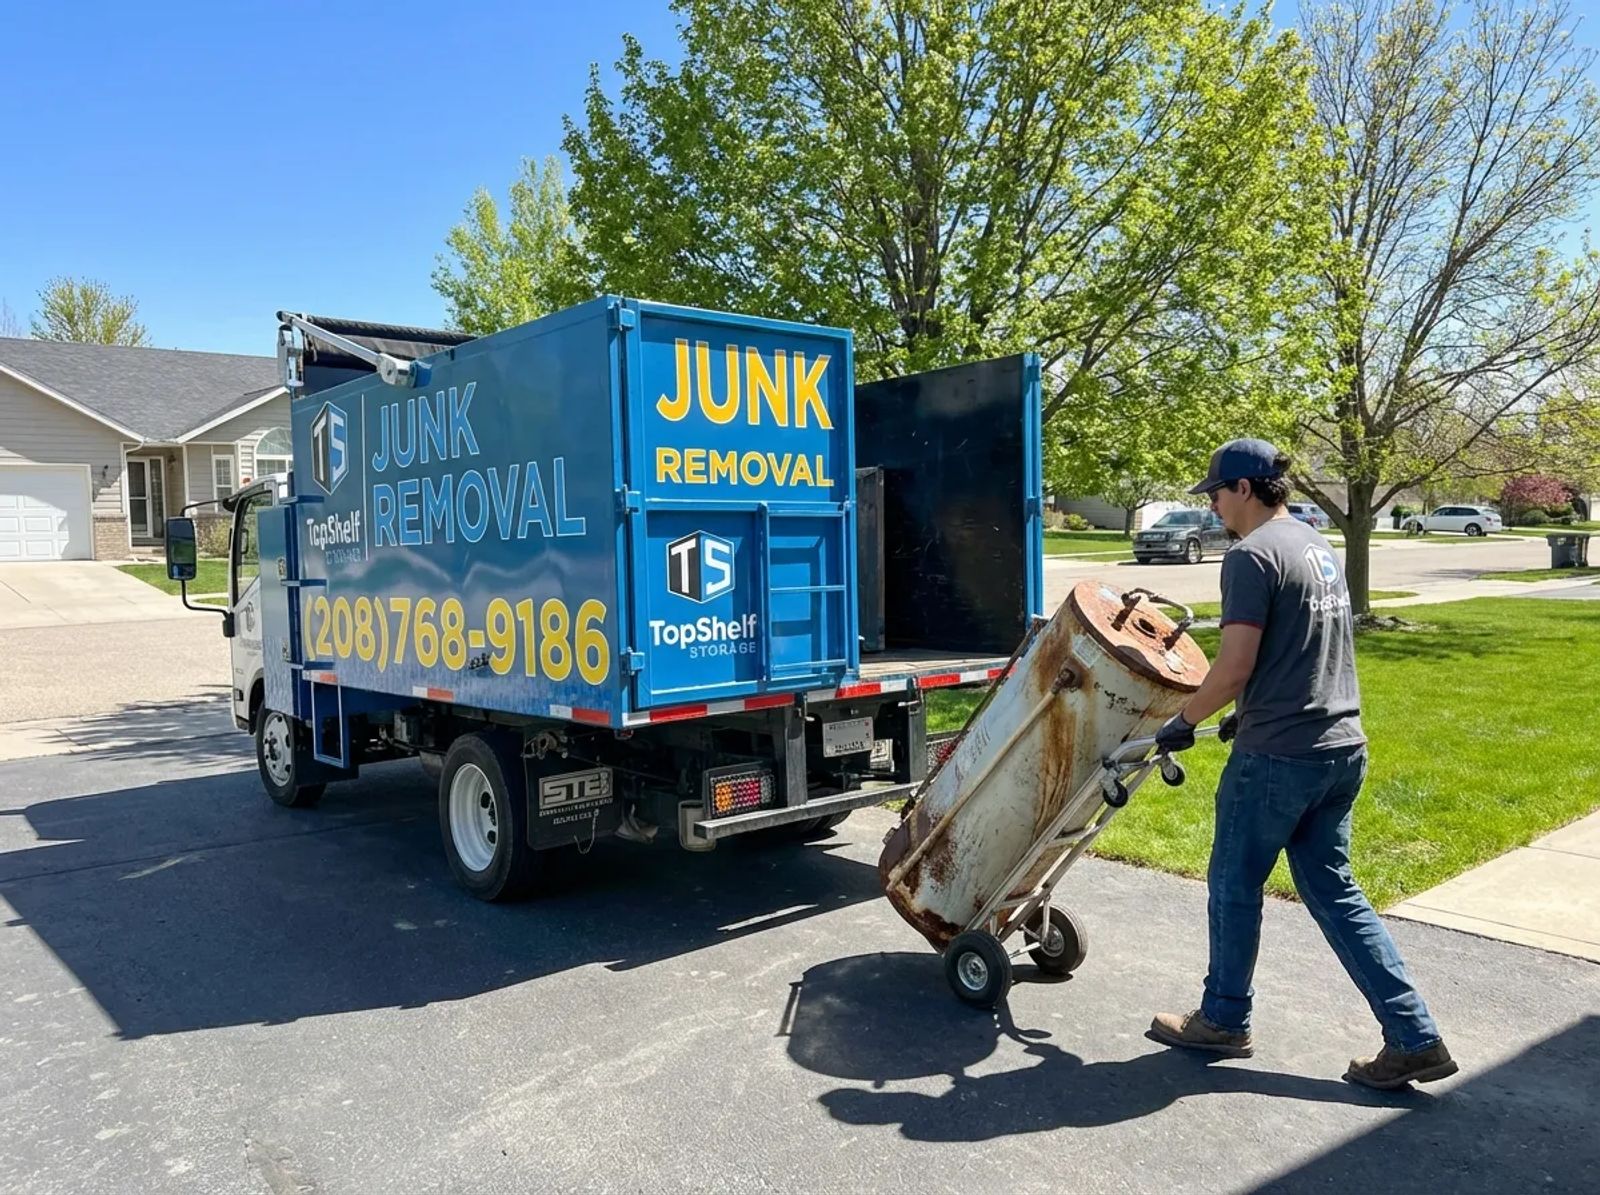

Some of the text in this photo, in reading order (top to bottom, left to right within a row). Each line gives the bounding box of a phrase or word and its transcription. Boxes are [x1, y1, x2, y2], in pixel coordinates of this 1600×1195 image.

[656, 338, 834, 429] JUNK
[313, 411, 346, 482] TS
[372, 382, 480, 472] JUNK
[373, 456, 587, 547] REMOVAL
[656, 446, 835, 487] REMOVAL
[670, 537, 731, 595] TS
[304, 594, 610, 686] (208)768-9186
[649, 613, 758, 649] TopShelf
[689, 641, 756, 659] STORAGE
